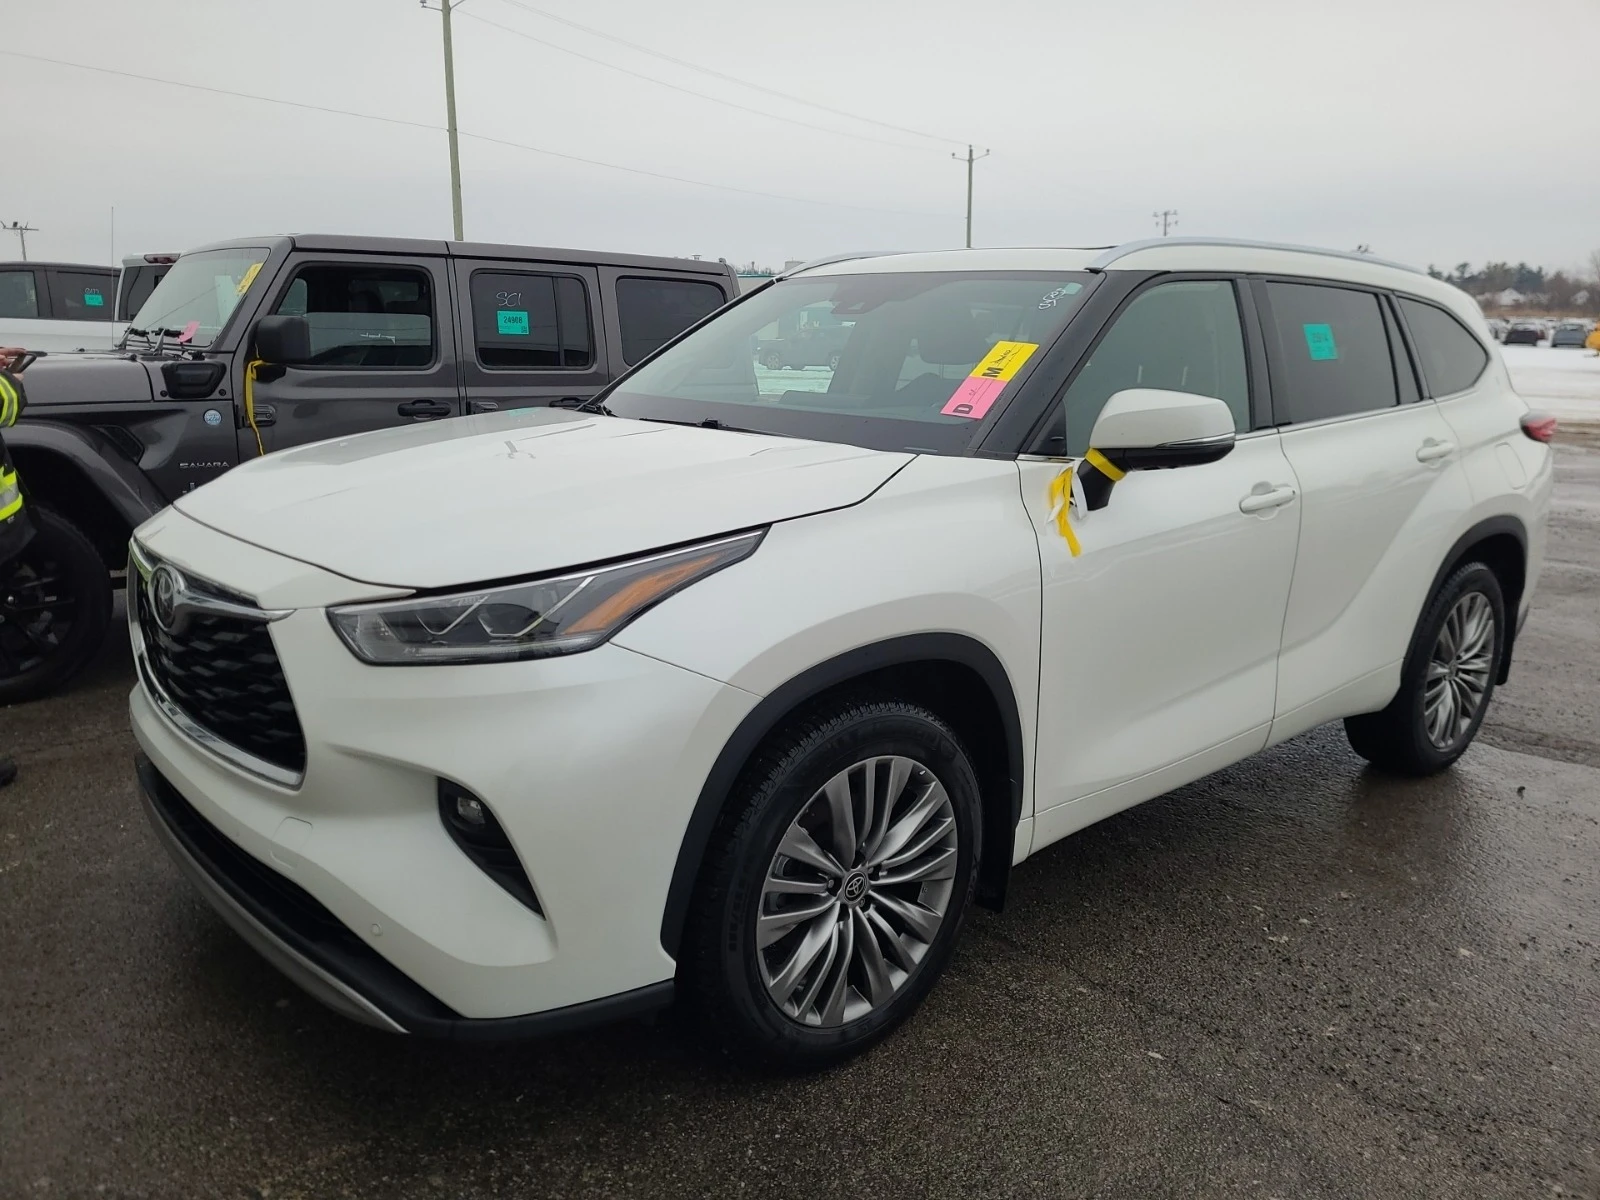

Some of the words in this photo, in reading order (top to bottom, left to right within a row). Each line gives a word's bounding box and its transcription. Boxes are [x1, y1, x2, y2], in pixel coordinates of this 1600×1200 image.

[981, 366, 1004, 378] M
[952, 403, 974, 415] D
[179, 461, 230, 469] SAHARA
